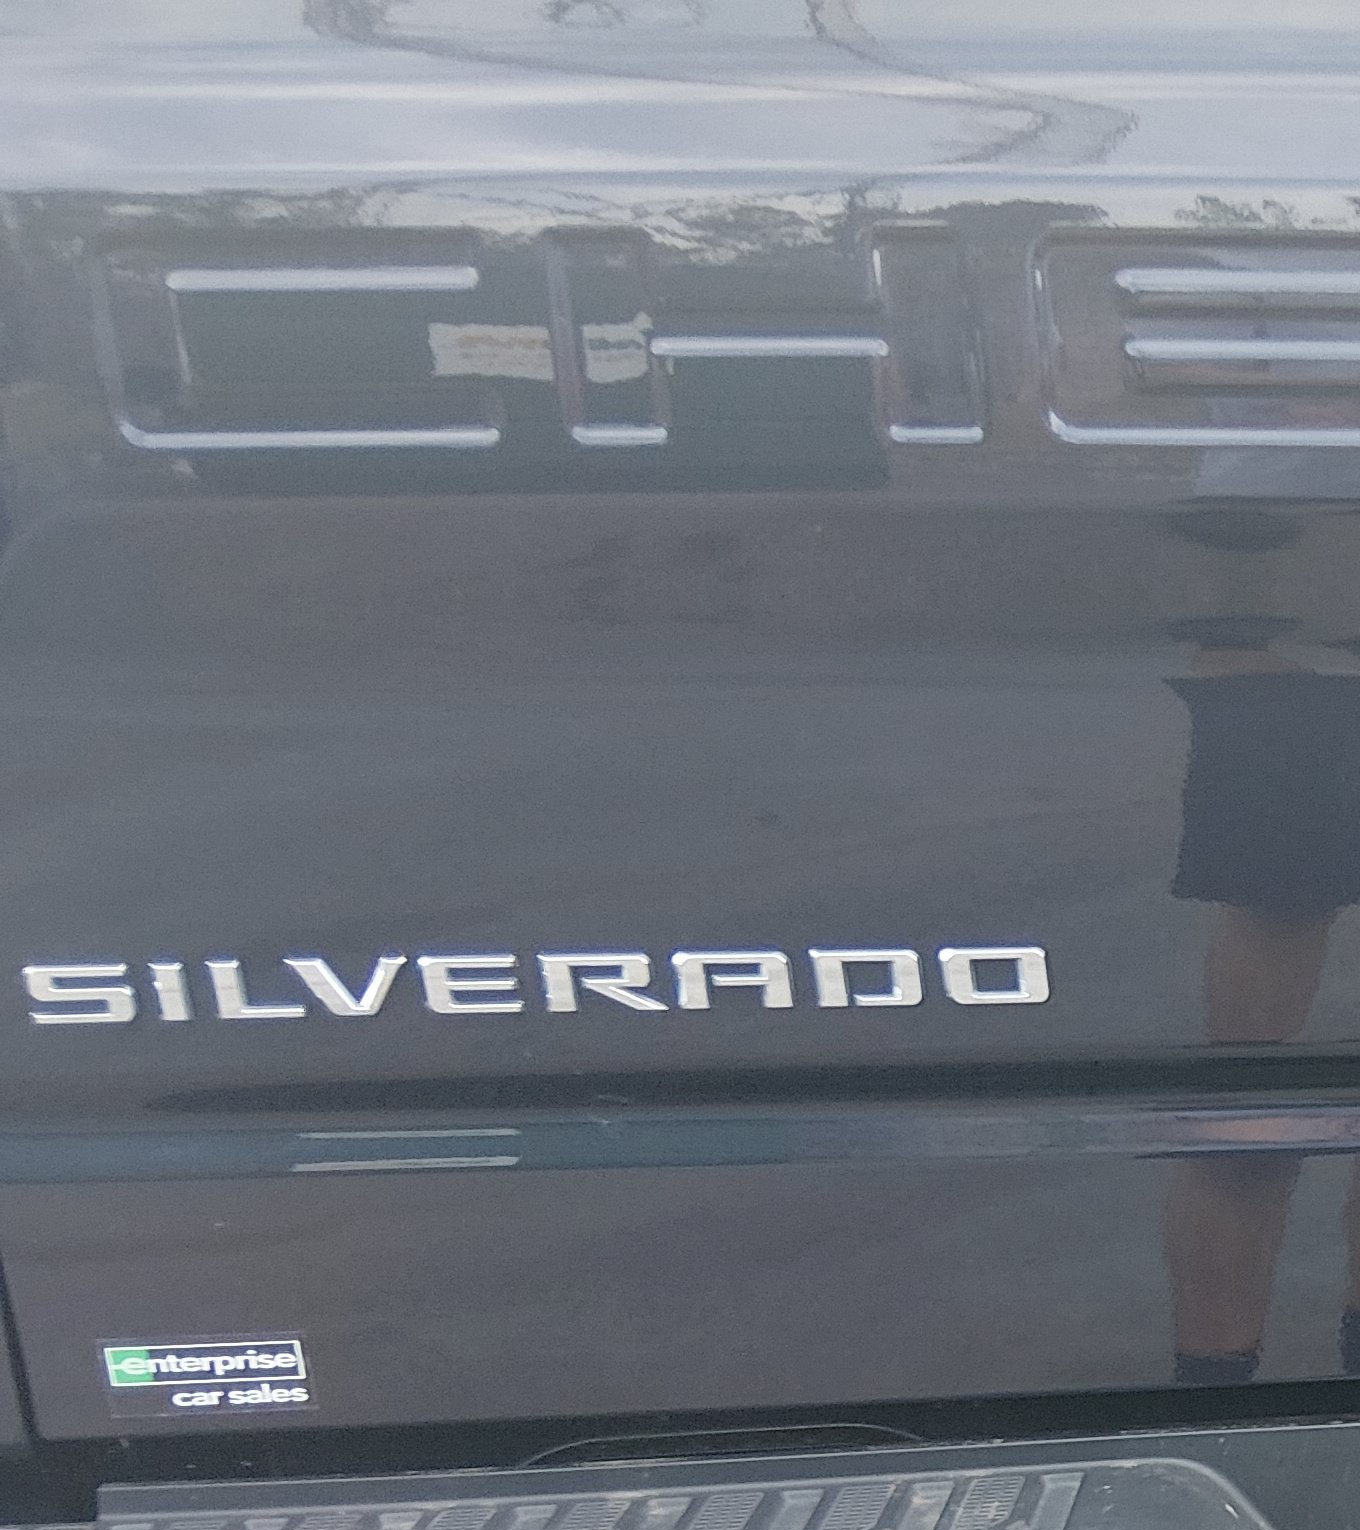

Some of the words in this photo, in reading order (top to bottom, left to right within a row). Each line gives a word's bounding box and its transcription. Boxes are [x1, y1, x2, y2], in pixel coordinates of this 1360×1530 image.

[21, 946, 1051, 1025] SILVERADO
[113, 1349, 298, 1376] enterprise
[171, 1387, 224, 1407] car
[228, 1383, 310, 1405] sales
